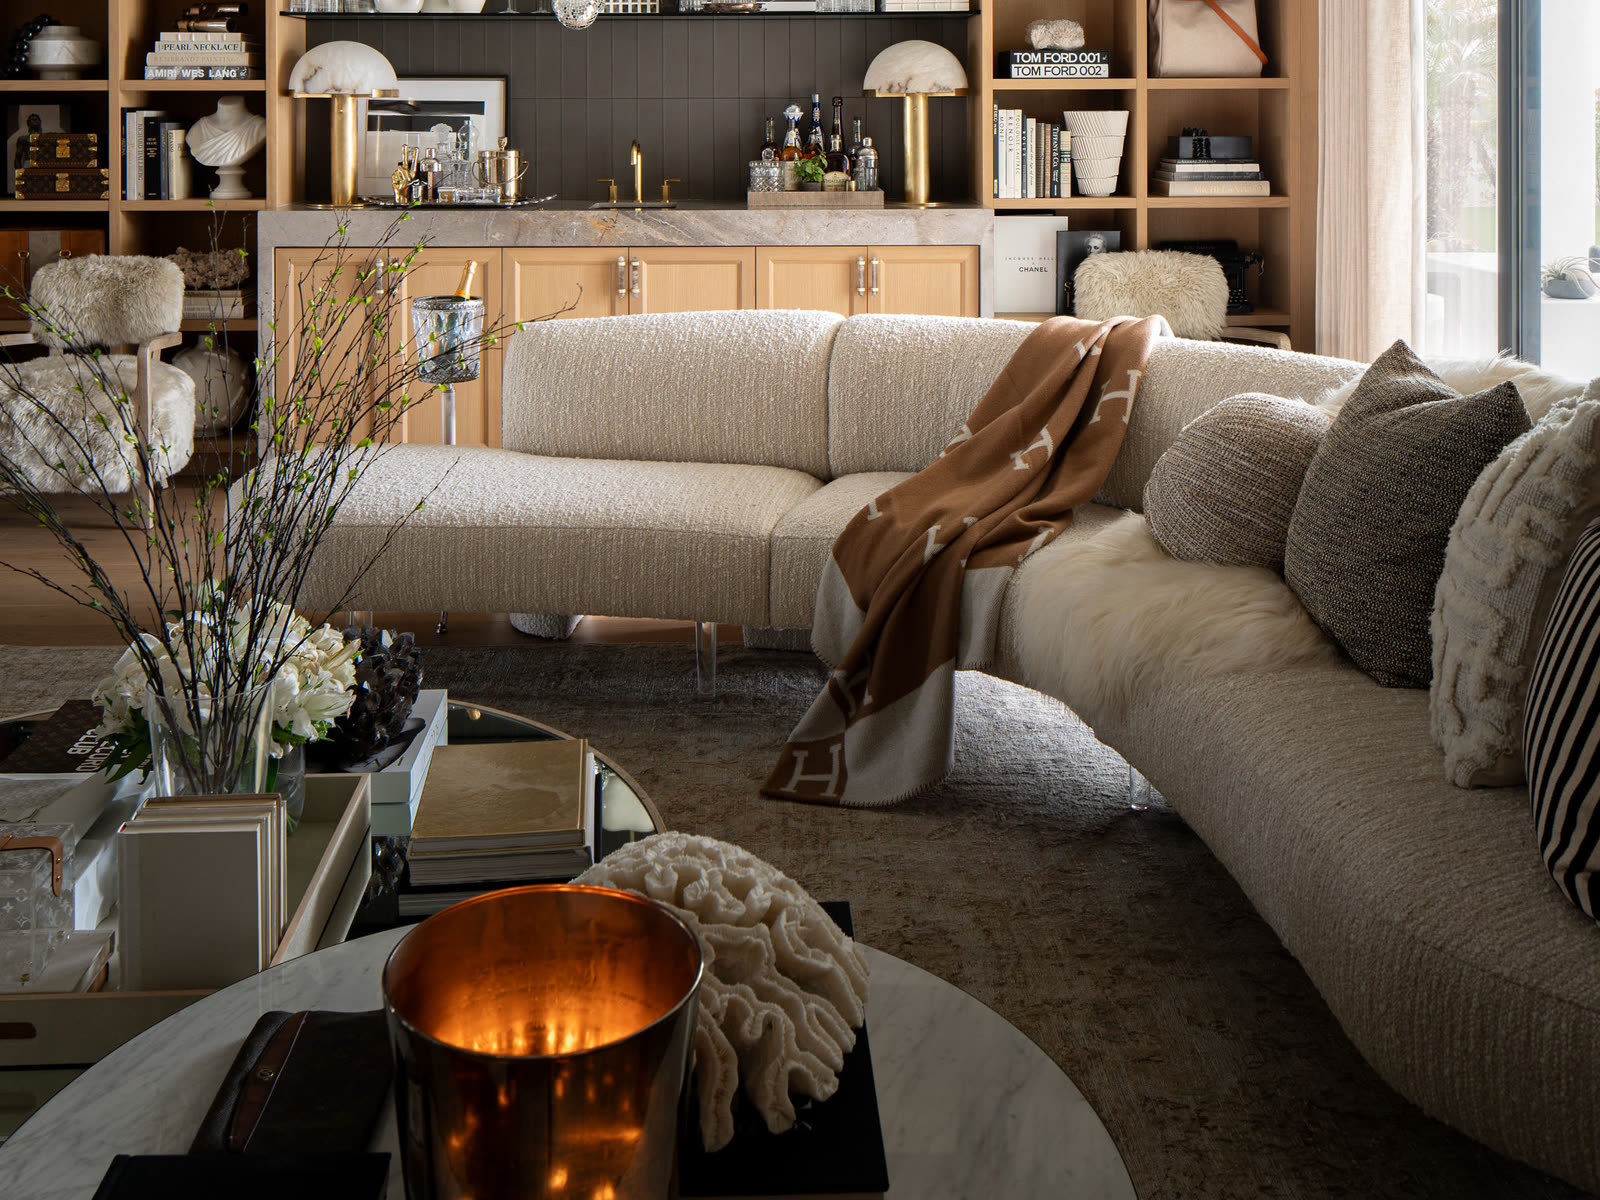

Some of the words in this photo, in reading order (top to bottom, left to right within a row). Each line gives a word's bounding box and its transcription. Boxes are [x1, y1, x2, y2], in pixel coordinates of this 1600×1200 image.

[164, 43, 191, 51] PEARL
[194, 43, 239, 51] NECKLACE
[1014, 52, 1041, 63] TOM
[1043, 52, 1078, 63] FORD
[1079, 52, 1101, 63] 001
[147, 69, 177, 78] AMIRI
[181, 69, 205, 78] WES
[208, 69, 237, 78] LANG
[1014, 66, 1041, 76] TOM
[1044, 66, 1078, 76] FORD
[1080, 65, 1102, 76] 002
[66, 728, 100, 755] CLUB
[780, 743, 842, 797] H
